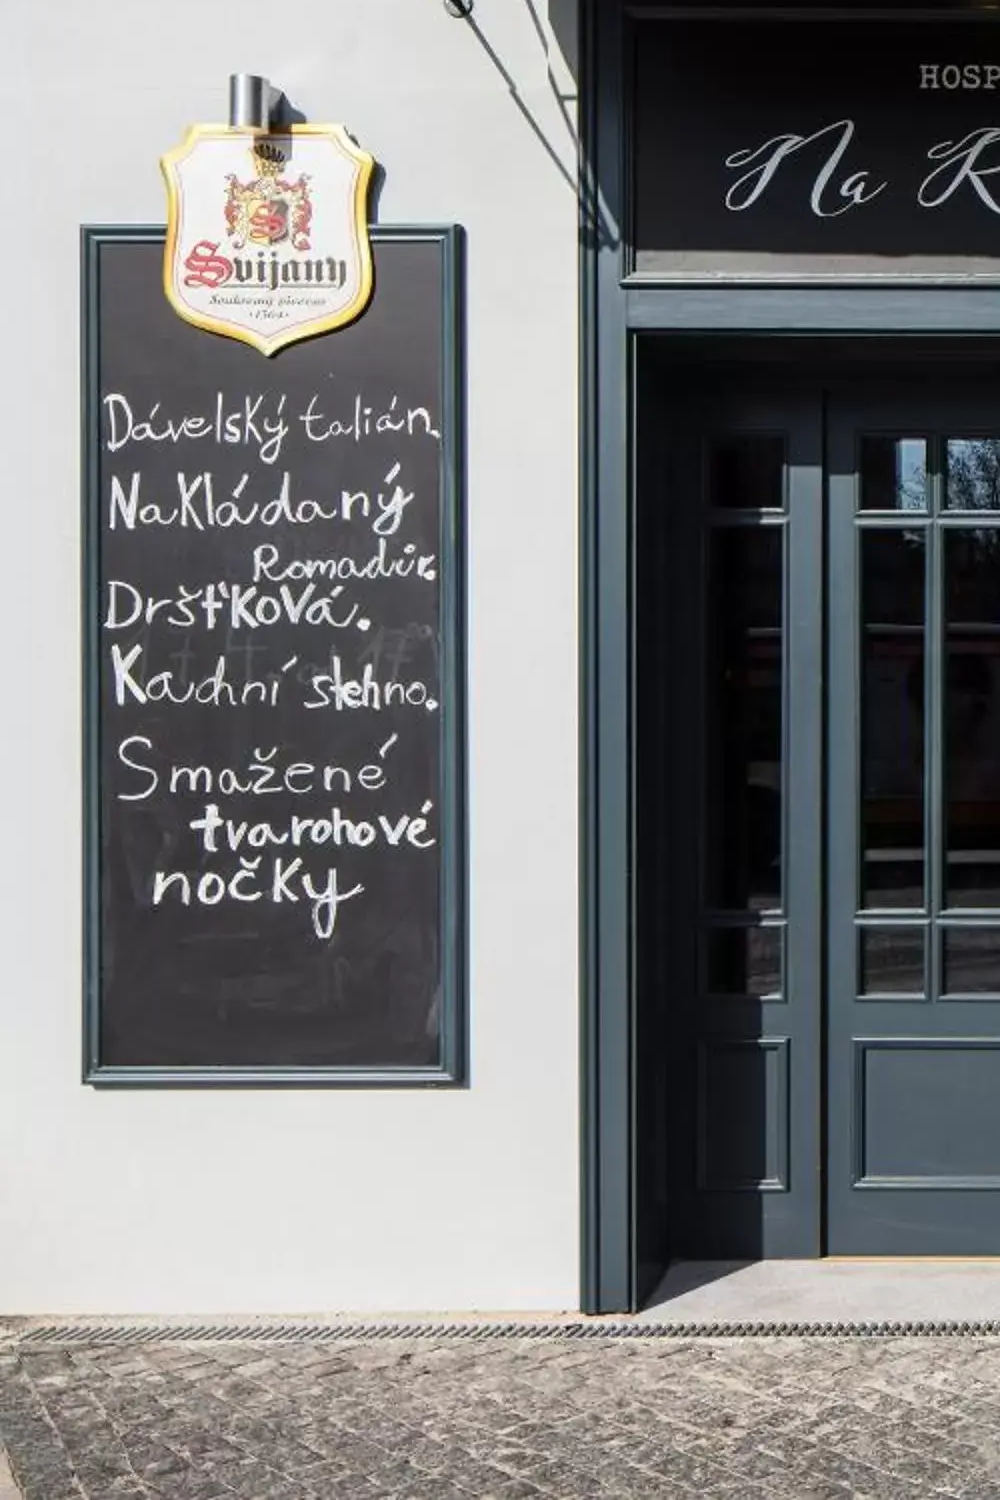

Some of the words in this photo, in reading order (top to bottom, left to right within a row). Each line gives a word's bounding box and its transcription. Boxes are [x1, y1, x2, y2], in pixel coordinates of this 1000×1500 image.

[725, 119, 888, 217] Na
[184, 239, 347, 292] Svijany
[117, 733, 399, 801] Smažené
[189, 800, 437, 852] tvarohové
